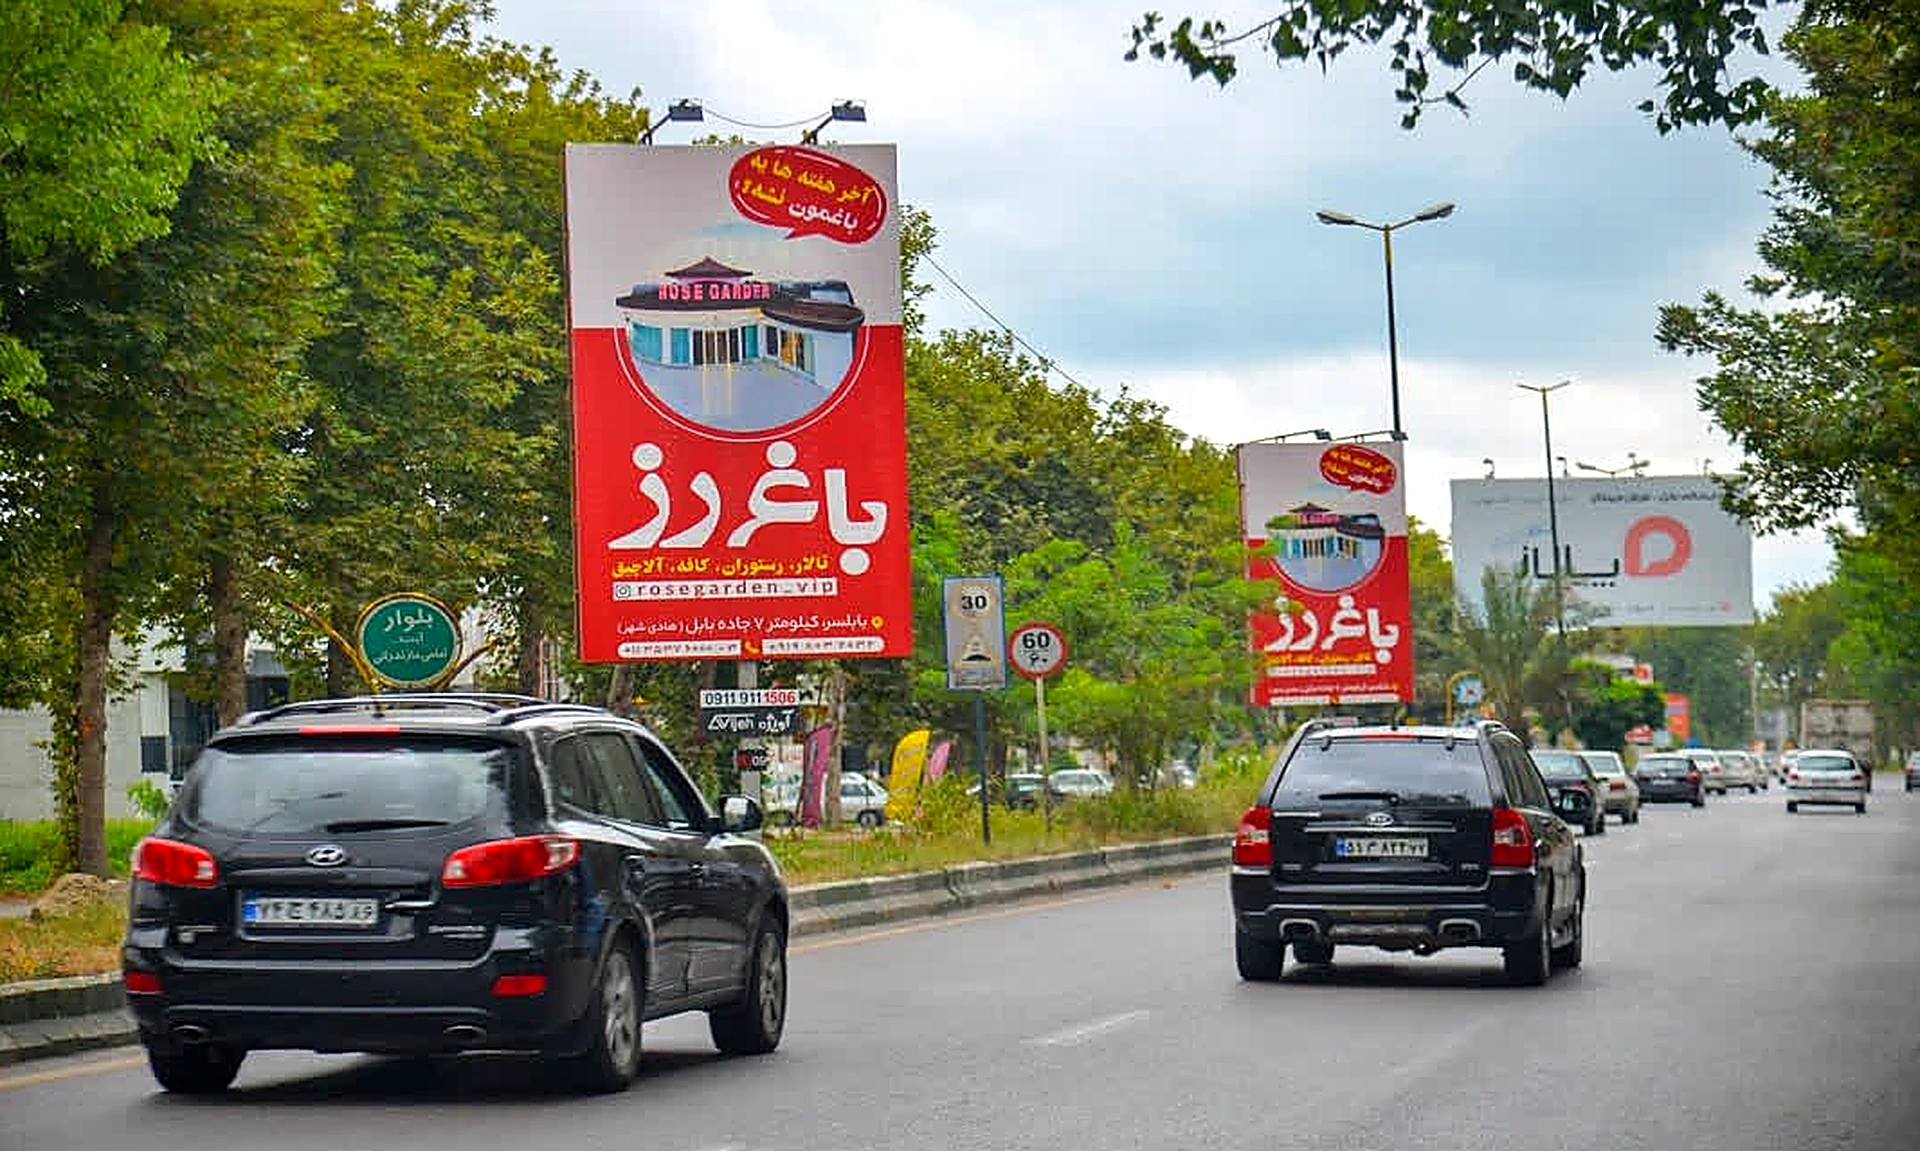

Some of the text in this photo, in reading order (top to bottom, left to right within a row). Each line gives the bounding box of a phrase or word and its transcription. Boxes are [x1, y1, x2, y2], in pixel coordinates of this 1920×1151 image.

[773, 159, 792, 179] ها
[607, 440, 888, 576] باغ رز
[961, 596, 988, 610] 30
[384, 607, 434, 632] بلوار
[684, 618, 715, 636] بابل
[717, 616, 751, 633] جاده
[765, 614, 820, 634] کیلومتر
[1264, 594, 1400, 664] باغ رز
[1022, 632, 1050, 649] 60
[705, 692, 735, 705] 0911
